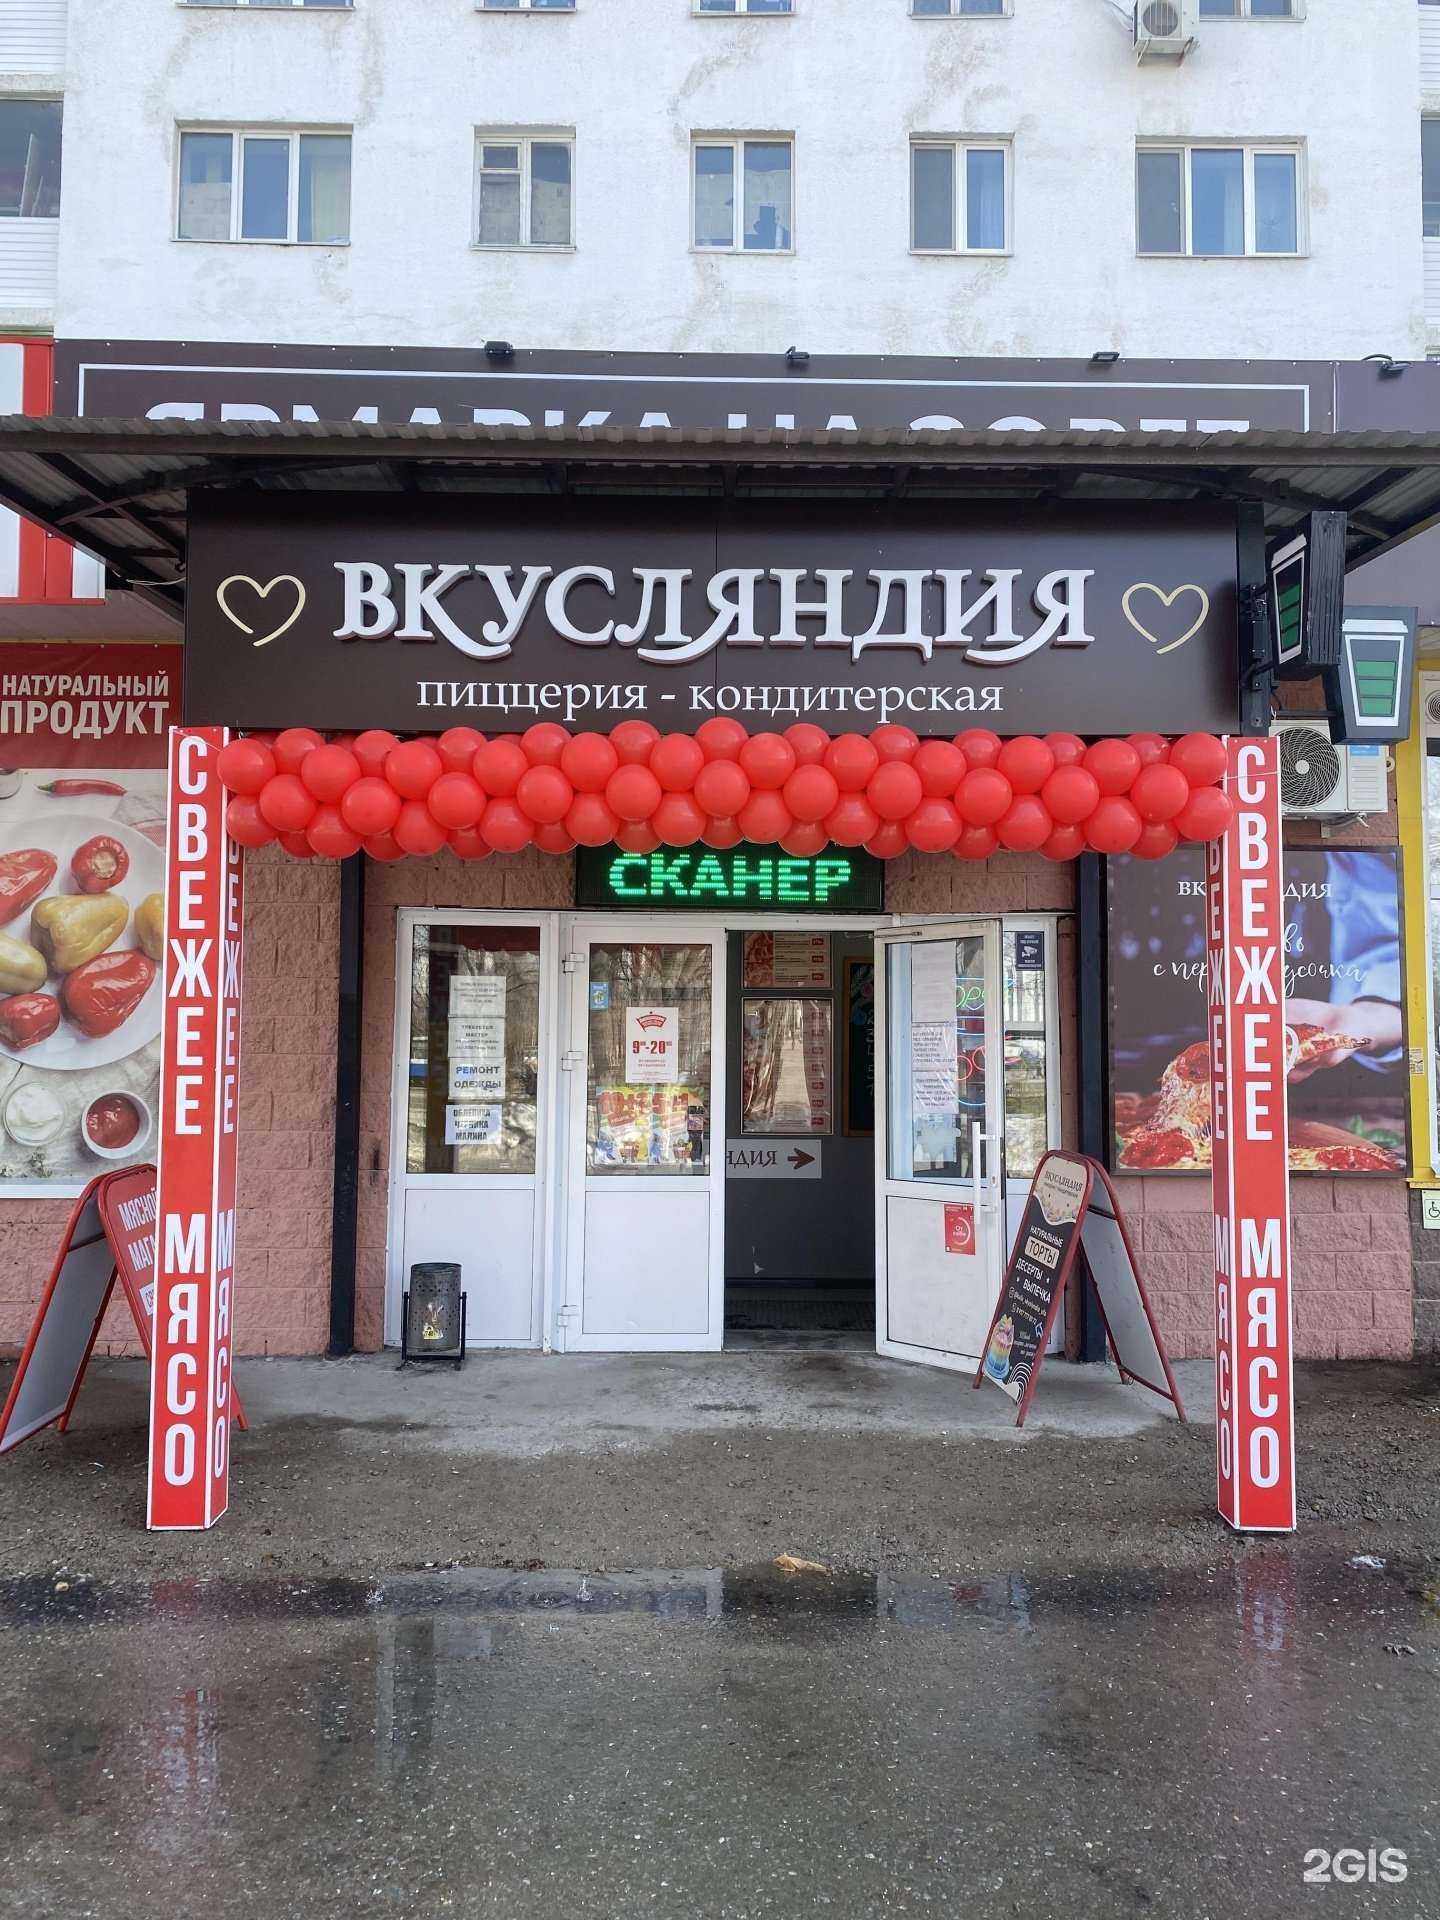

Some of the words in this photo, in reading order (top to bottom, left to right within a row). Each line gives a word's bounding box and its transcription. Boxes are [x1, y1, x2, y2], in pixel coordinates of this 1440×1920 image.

[333, 561, 1096, 664] ВКУСЛЯНДИЯ
[2, 670, 169, 696] НАТУРАЛЬНЫЙ
[416, 681, 648, 721] пиццерия
[688, 684, 1004, 724] кондитерская
[0, 700, 170, 739] ПРОДУКТ
[609, 853, 850, 901] СКАНЕР
[168, 735, 213, 1135] СВЕЖЕЕ
[1234, 745, 1278, 1140] СВЕЖЕЕ
[454, 1080, 502, 1090] ОДЕЖДЫ
[455, 1066, 501, 1074] РЕМОНТ
[1016, 1257, 1043, 1281] ДЕСЕРТЫ
[1029, 1241, 1056, 1264] ТОРТЫ
[164, 1213, 206, 1485] МЯСО
[214, 1209, 234, 1478] МЯСО
[1215, 1214, 1231, 1480] МЯСО
[1241, 1219, 1282, 1488] МЯСО
